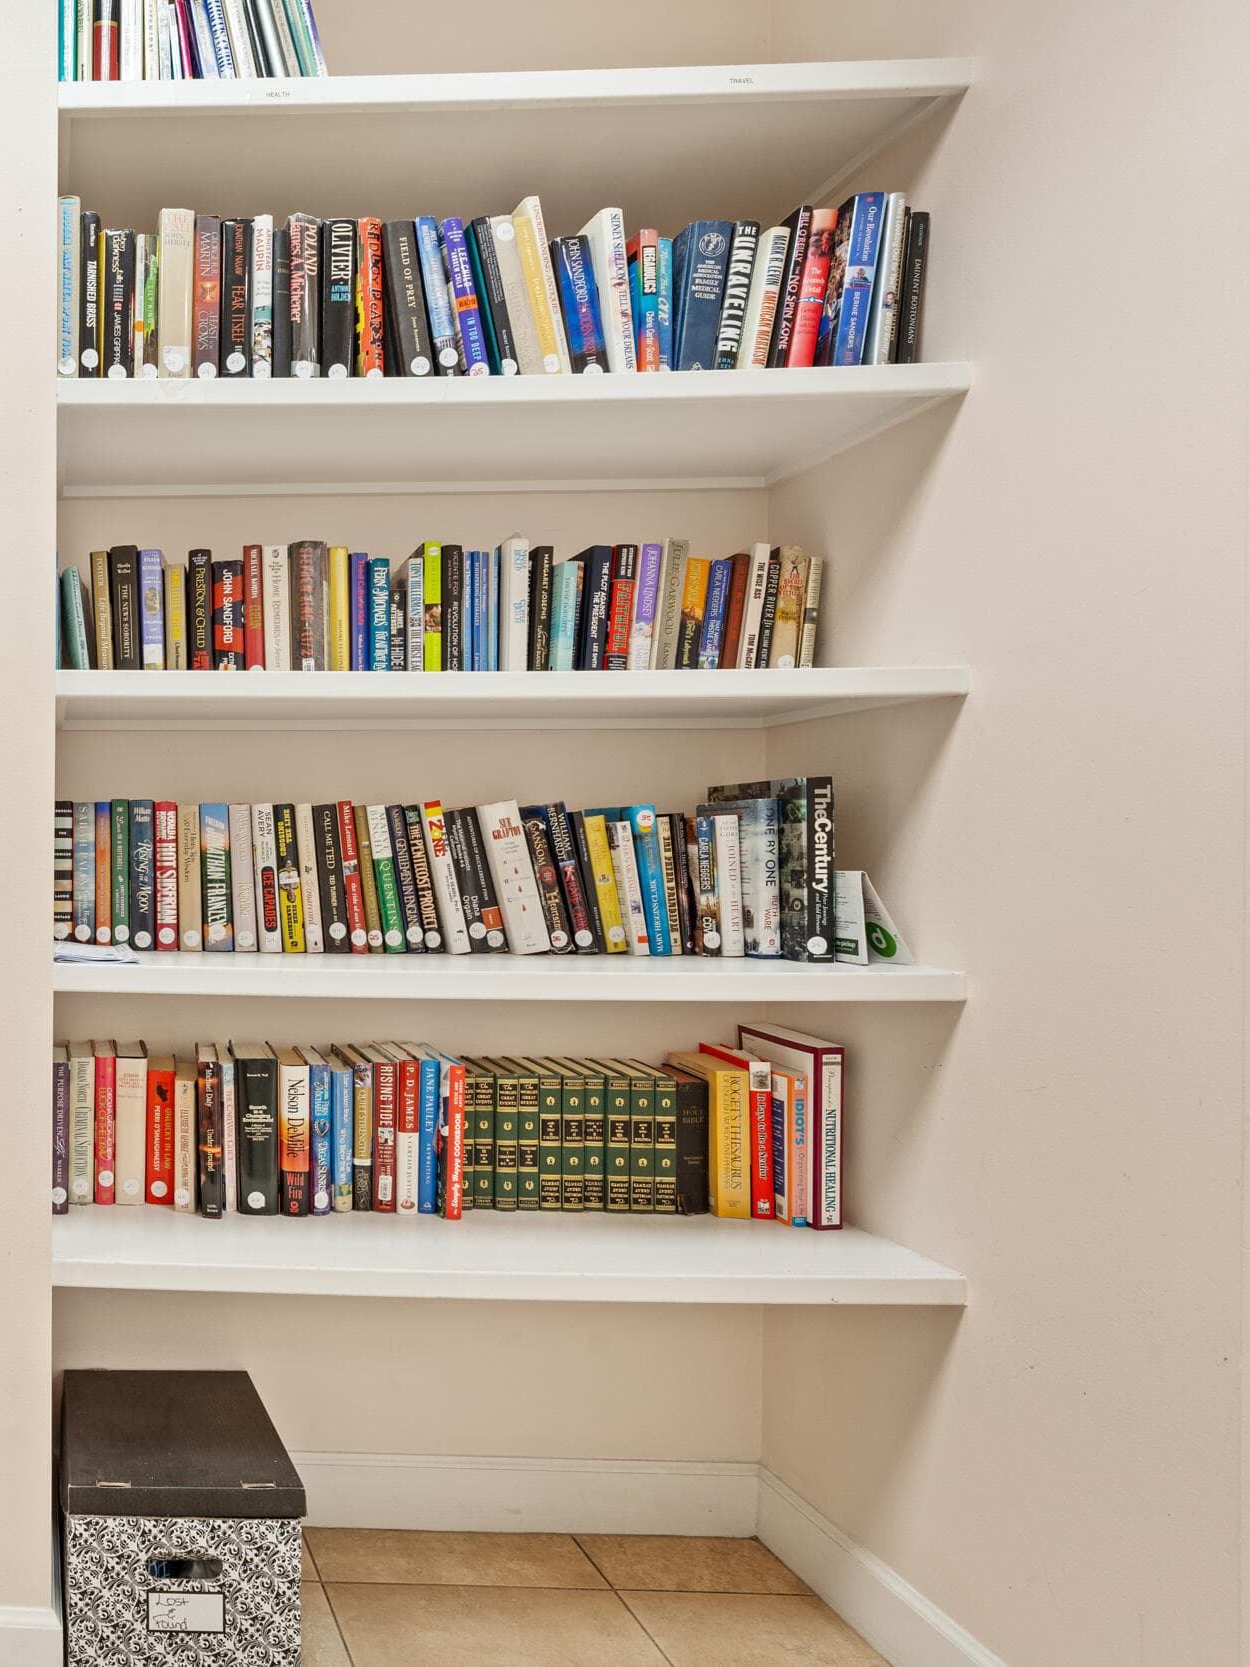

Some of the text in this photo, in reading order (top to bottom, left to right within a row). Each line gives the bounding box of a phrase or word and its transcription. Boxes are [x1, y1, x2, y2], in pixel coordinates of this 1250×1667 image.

[305, 223, 317, 275] POLAND
[327, 222, 356, 280] OLIVIER
[399, 237, 416, 308] FIELD OF PREY
[458, 247, 471, 287] LEE CHILD
[765, 234, 787, 286] MARK LEVIN
[232, 286, 245, 309] FEAR
[719, 235, 756, 353] UNRAVELING
[779, 275, 800, 350] NO SPIN ZONE
[907, 258, 923, 344] EMINENT BOSTONIANS
[196, 568, 206, 648] PRESTON CHILD
[223, 570, 232, 643] JOHN SANDFORD
[754, 573, 763, 599] WISE ASS
[764, 564, 779, 618] COPPER RIVER
[590, 604, 599, 638] PRESIDENT
[613, 583, 631, 651] FAITHFUL
[323, 811, 336, 869] CALL ME TED
[342, 805, 354, 856] Mike Leonard
[492, 828, 520, 840] GRAFTON
[499, 817, 511, 828] SUE
[557, 812, 571, 852] WILLIAM
[157, 843, 175, 867] HOT
[207, 828, 225, 879] JONATHAN
[766, 840, 776, 887] BY ONE
[263, 871, 276, 927] ICE CAPADES
[411, 839, 436, 930] PENTECOST PROJECT
[205, 1069, 214, 1092] Michael
[380, 1066, 392, 1126] RISING TIDE
[425, 1067, 434, 1133] JANE PAULEY
[287, 1078, 305, 1157] Nelson DeMille
[404, 1093, 414, 1129] JAMES
[730, 1076, 742, 1190] ROGET'S THESAURUS
[795, 1098, 805, 1145] IDIOT'S
[760, 1152, 768, 1179] Senior
[825, 1109, 837, 1170] NUTRITIONAL
